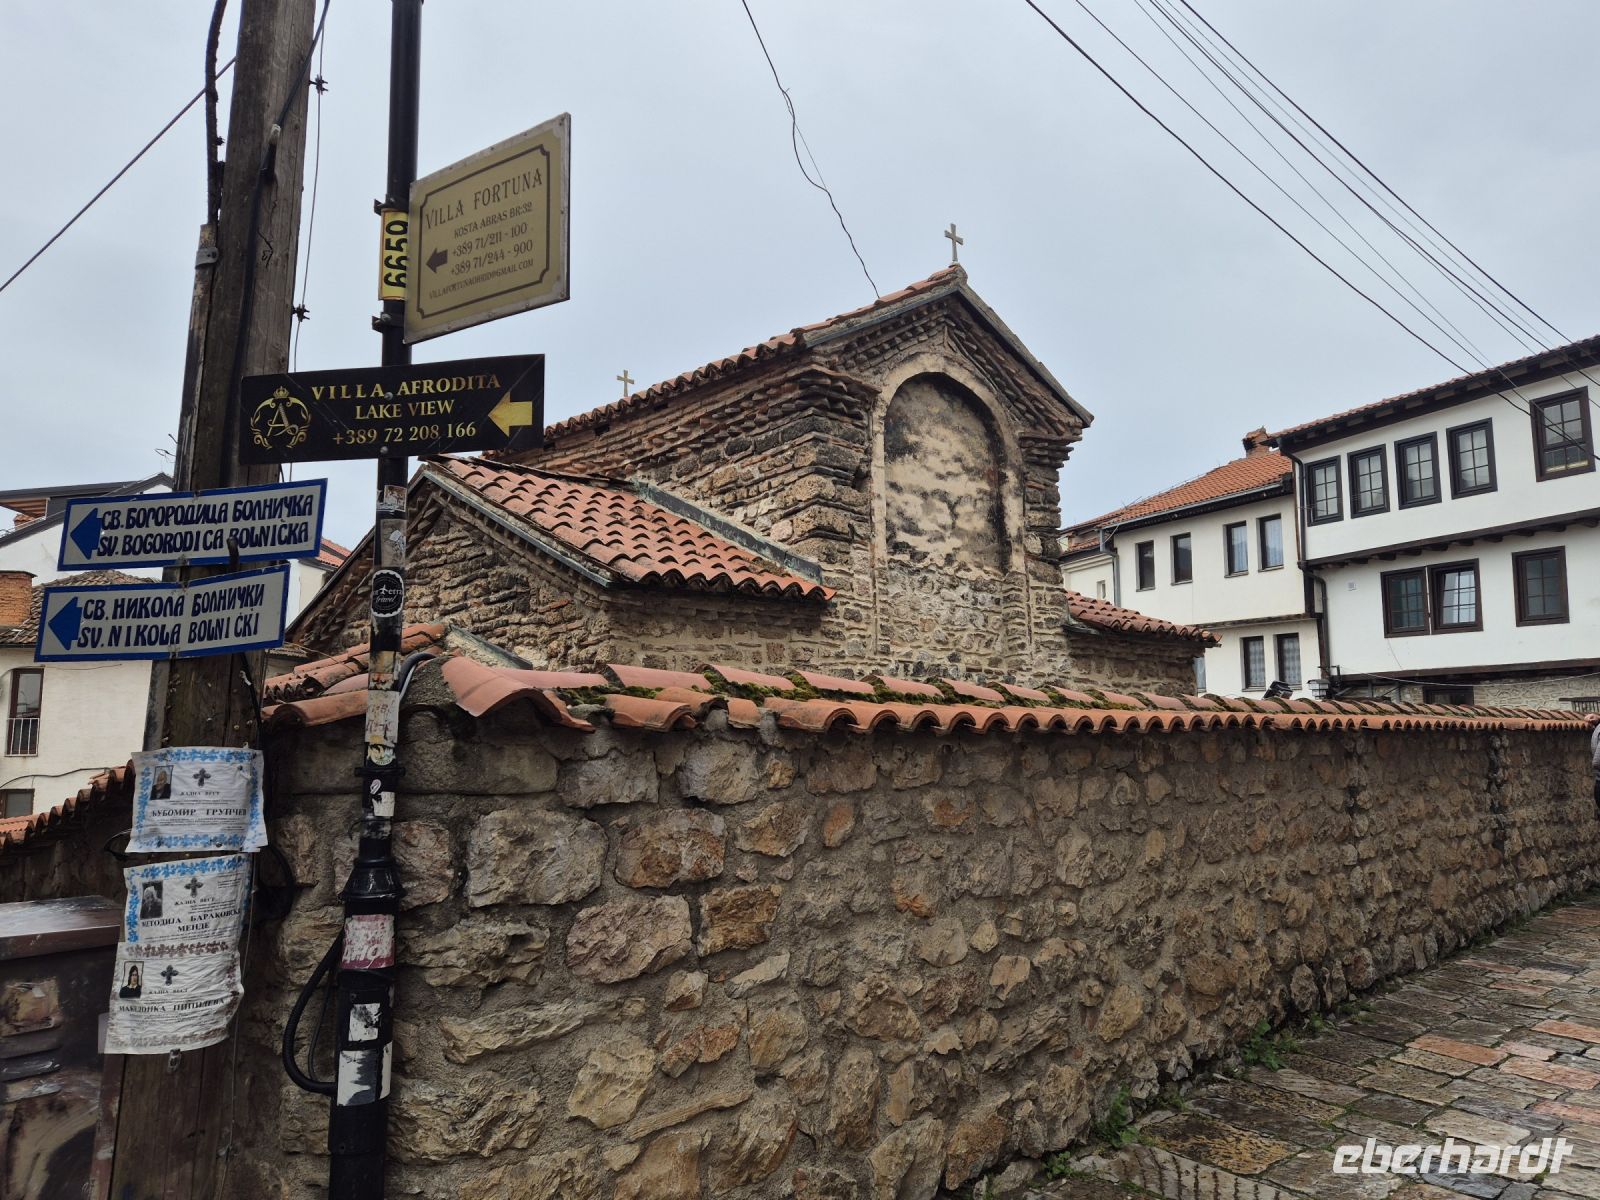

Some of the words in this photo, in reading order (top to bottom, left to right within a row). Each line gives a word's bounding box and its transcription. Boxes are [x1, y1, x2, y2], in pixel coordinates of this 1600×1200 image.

[426, 200, 464, 229] VILLA
[474, 168, 542, 210] FORTUNA
[454, 222, 478, 239] KOSTA
[480, 210, 508, 229] ABRAS
[452, 241, 473, 257] +389
[511, 222, 528, 238] 100
[450, 260, 471, 276] +389
[513, 240, 533, 258] 900
[311, 383, 386, 400] VILLA
[397, 374, 501, 396] AFRODITA
[355, 403, 402, 420] LAKE
[408, 400, 455, 416] VIEW
[332, 429, 378, 445] +389
[384, 427, 403, 443] 72
[409, 424, 440, 441] 208
[447, 421, 476, 438] 166
[232, 494, 314, 523] БОЛНИЧКА
[97, 535, 119, 556] SV.
[83, 599, 109, 620] СВ.
[112, 595, 185, 620] НИКОЛА
[191, 583, 265, 617] БОЛНИЧКИ
[77, 626, 104, 648] SV.
[107, 623, 181, 647] NIKOLA
